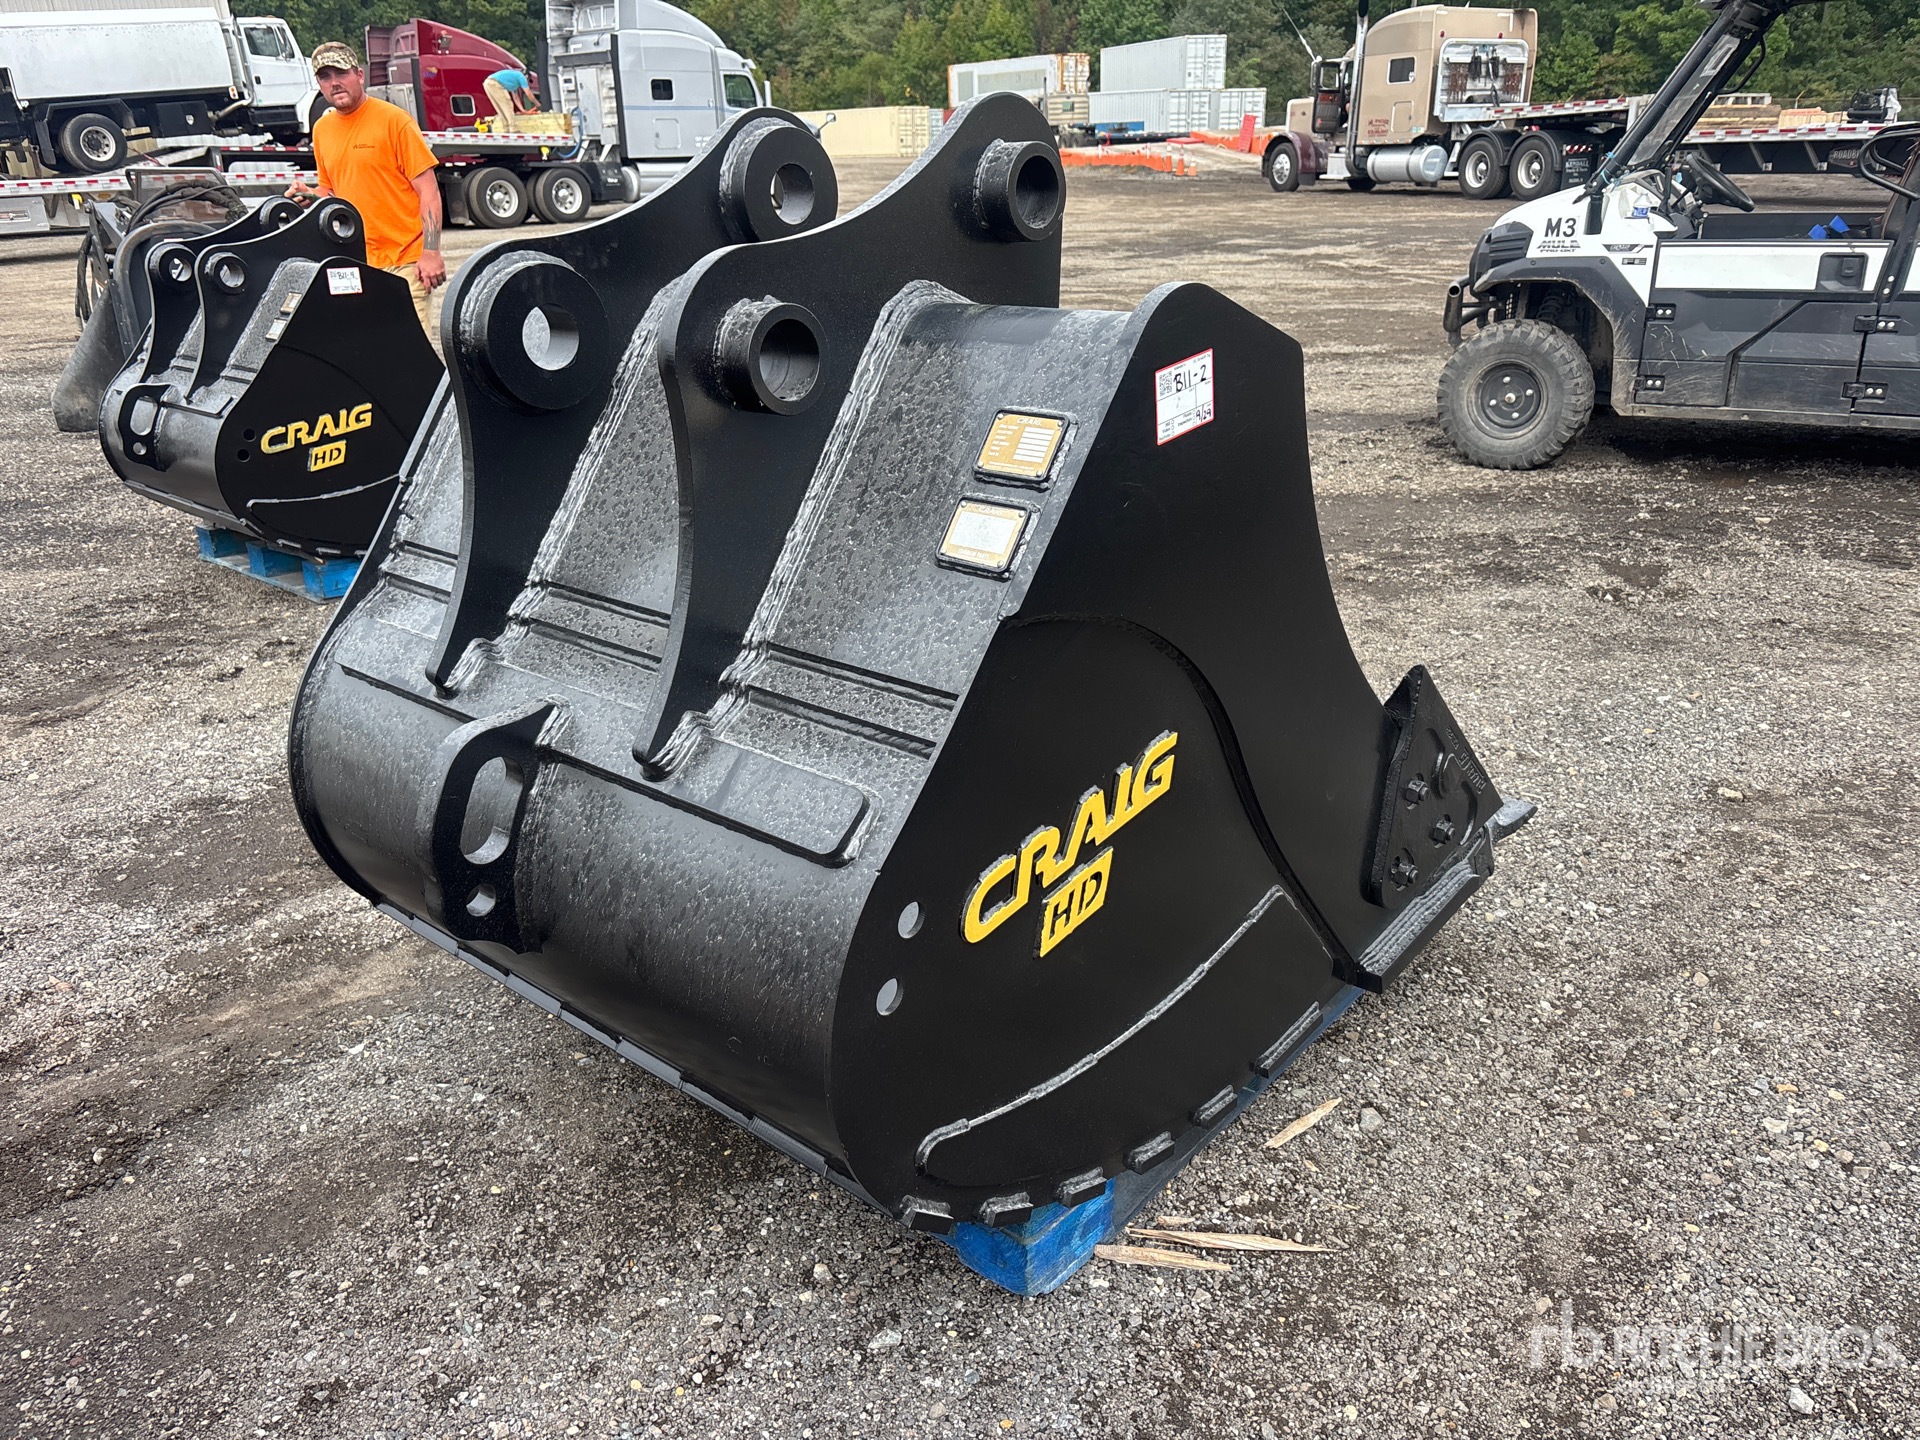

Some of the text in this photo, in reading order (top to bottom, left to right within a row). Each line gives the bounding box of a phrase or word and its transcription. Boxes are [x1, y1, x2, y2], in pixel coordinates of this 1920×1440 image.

[1544, 217, 1577, 237] M3
[1537, 240, 1581, 249] MULE
[1173, 364, 1207, 392] B11-2
[261, 402, 372, 454] CRAIG
[1016, 417, 1042, 426] CRAIG
[312, 446, 343, 467] HD
[960, 730, 1178, 943] CRAIG
[1045, 866, 1106, 944] HD
